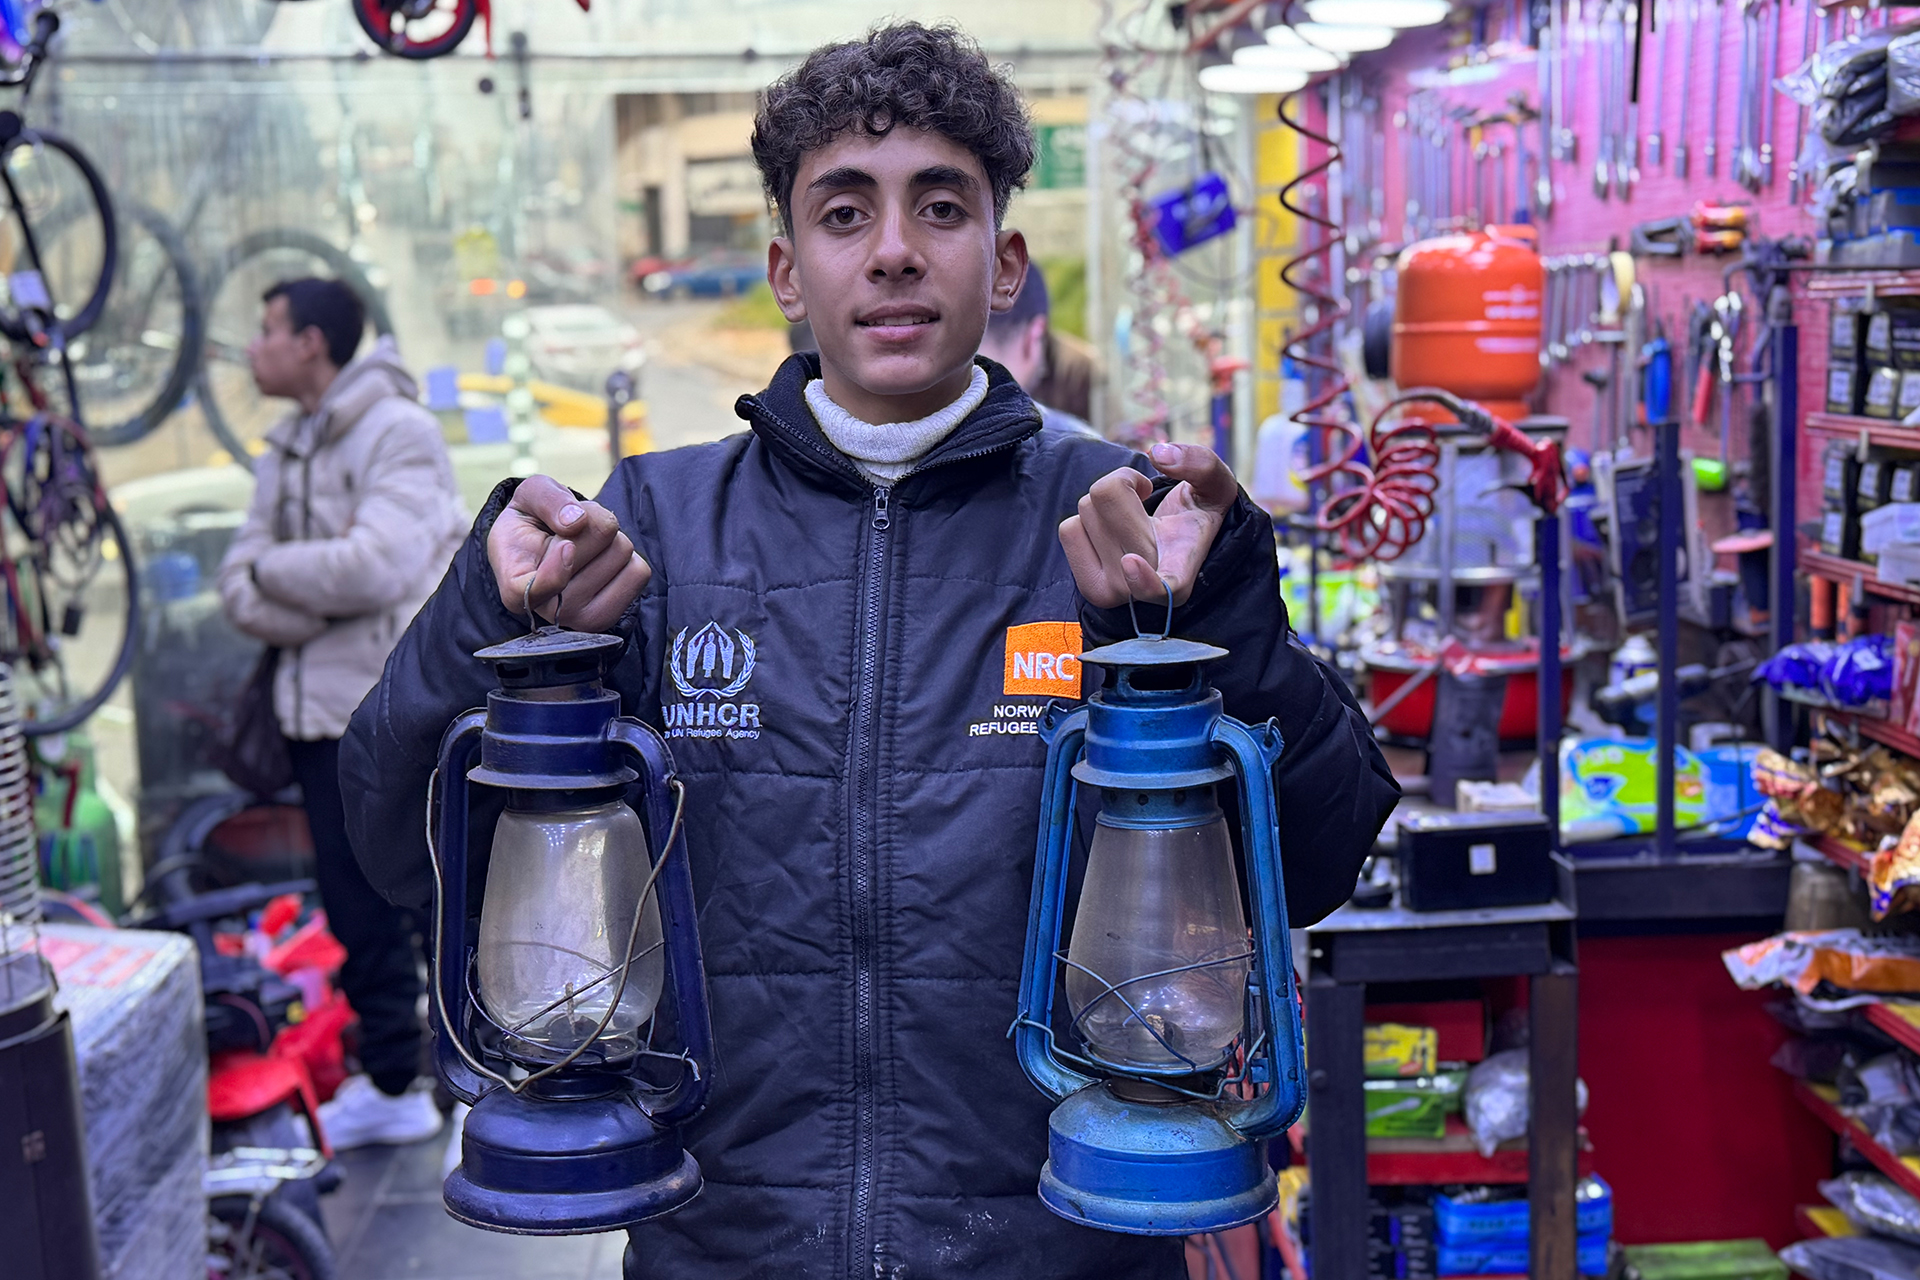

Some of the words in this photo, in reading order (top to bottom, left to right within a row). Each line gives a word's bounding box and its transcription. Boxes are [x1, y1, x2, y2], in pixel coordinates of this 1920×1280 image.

[1013, 652, 1075, 681] NRC
[661, 702, 761, 729] UNHCR
[993, 704, 1044, 718] NORW
[671, 728, 684, 738] UN
[686, 727, 722, 739] Refugee
[725, 728, 760, 740] Agency
[968, 721, 1039, 737] REFUGEE
